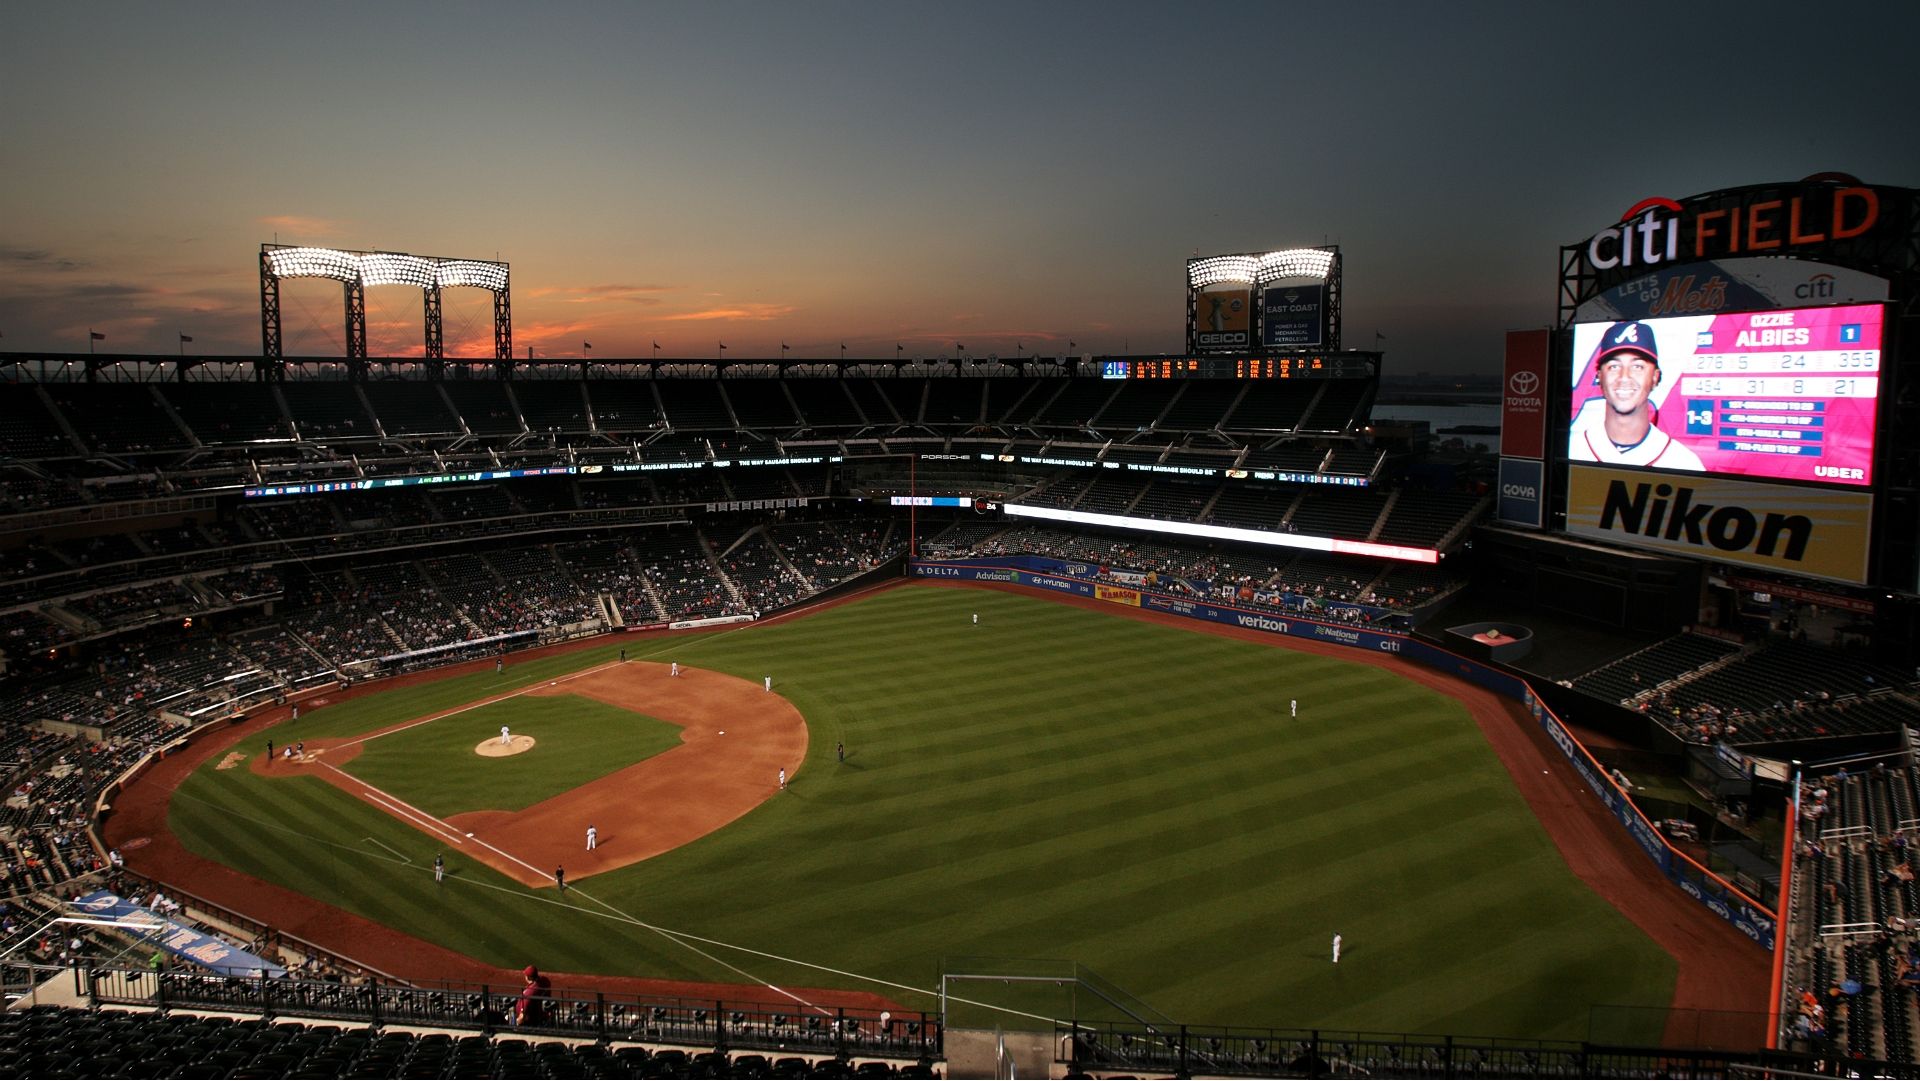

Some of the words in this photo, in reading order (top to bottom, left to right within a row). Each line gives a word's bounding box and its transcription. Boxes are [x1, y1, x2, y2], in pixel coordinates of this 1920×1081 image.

[1588, 210, 1679, 270] citi
[1695, 187, 1879, 257] FIELD
[1618, 274, 1658, 298] LET'S
[1794, 278, 1834, 299] citi
[1640, 288, 1660, 304] GO
[1651, 275, 1728, 316] Mets
[1266, 306, 1287, 314] EAST
[1289, 303, 1318, 312] COAST
[1750, 313, 1795, 327] OZZIE
[1200, 333, 1246, 344] GEICO
[1735, 328, 1810, 348] ALBIES
[1845, 328, 1855, 340] 1
[1738, 356, 1748, 370] 5
[1781, 355, 1806, 369] 24
[1747, 380, 1766, 394] 31
[1793, 380, 1804, 394] 8
[1834, 380, 1855, 394] 21
[1507, 397, 1542, 407] TOYOTA
[1687, 410, 1713, 425] 1-3
[1152, 465, 1179, 473] SAUSAGE
[1814, 465, 1864, 480] UBER
[1503, 483, 1535, 498] GOYA
[1599, 479, 1813, 561] Nikon
[926, 567, 960, 576] DELTA
[976, 571, 1011, 581] Advisors
[1043, 578, 1071, 589] HYUNDAI
[1237, 615, 1288, 633] verizon
[1325, 628, 1359, 639] National
[1380, 640, 1400, 652] citi
